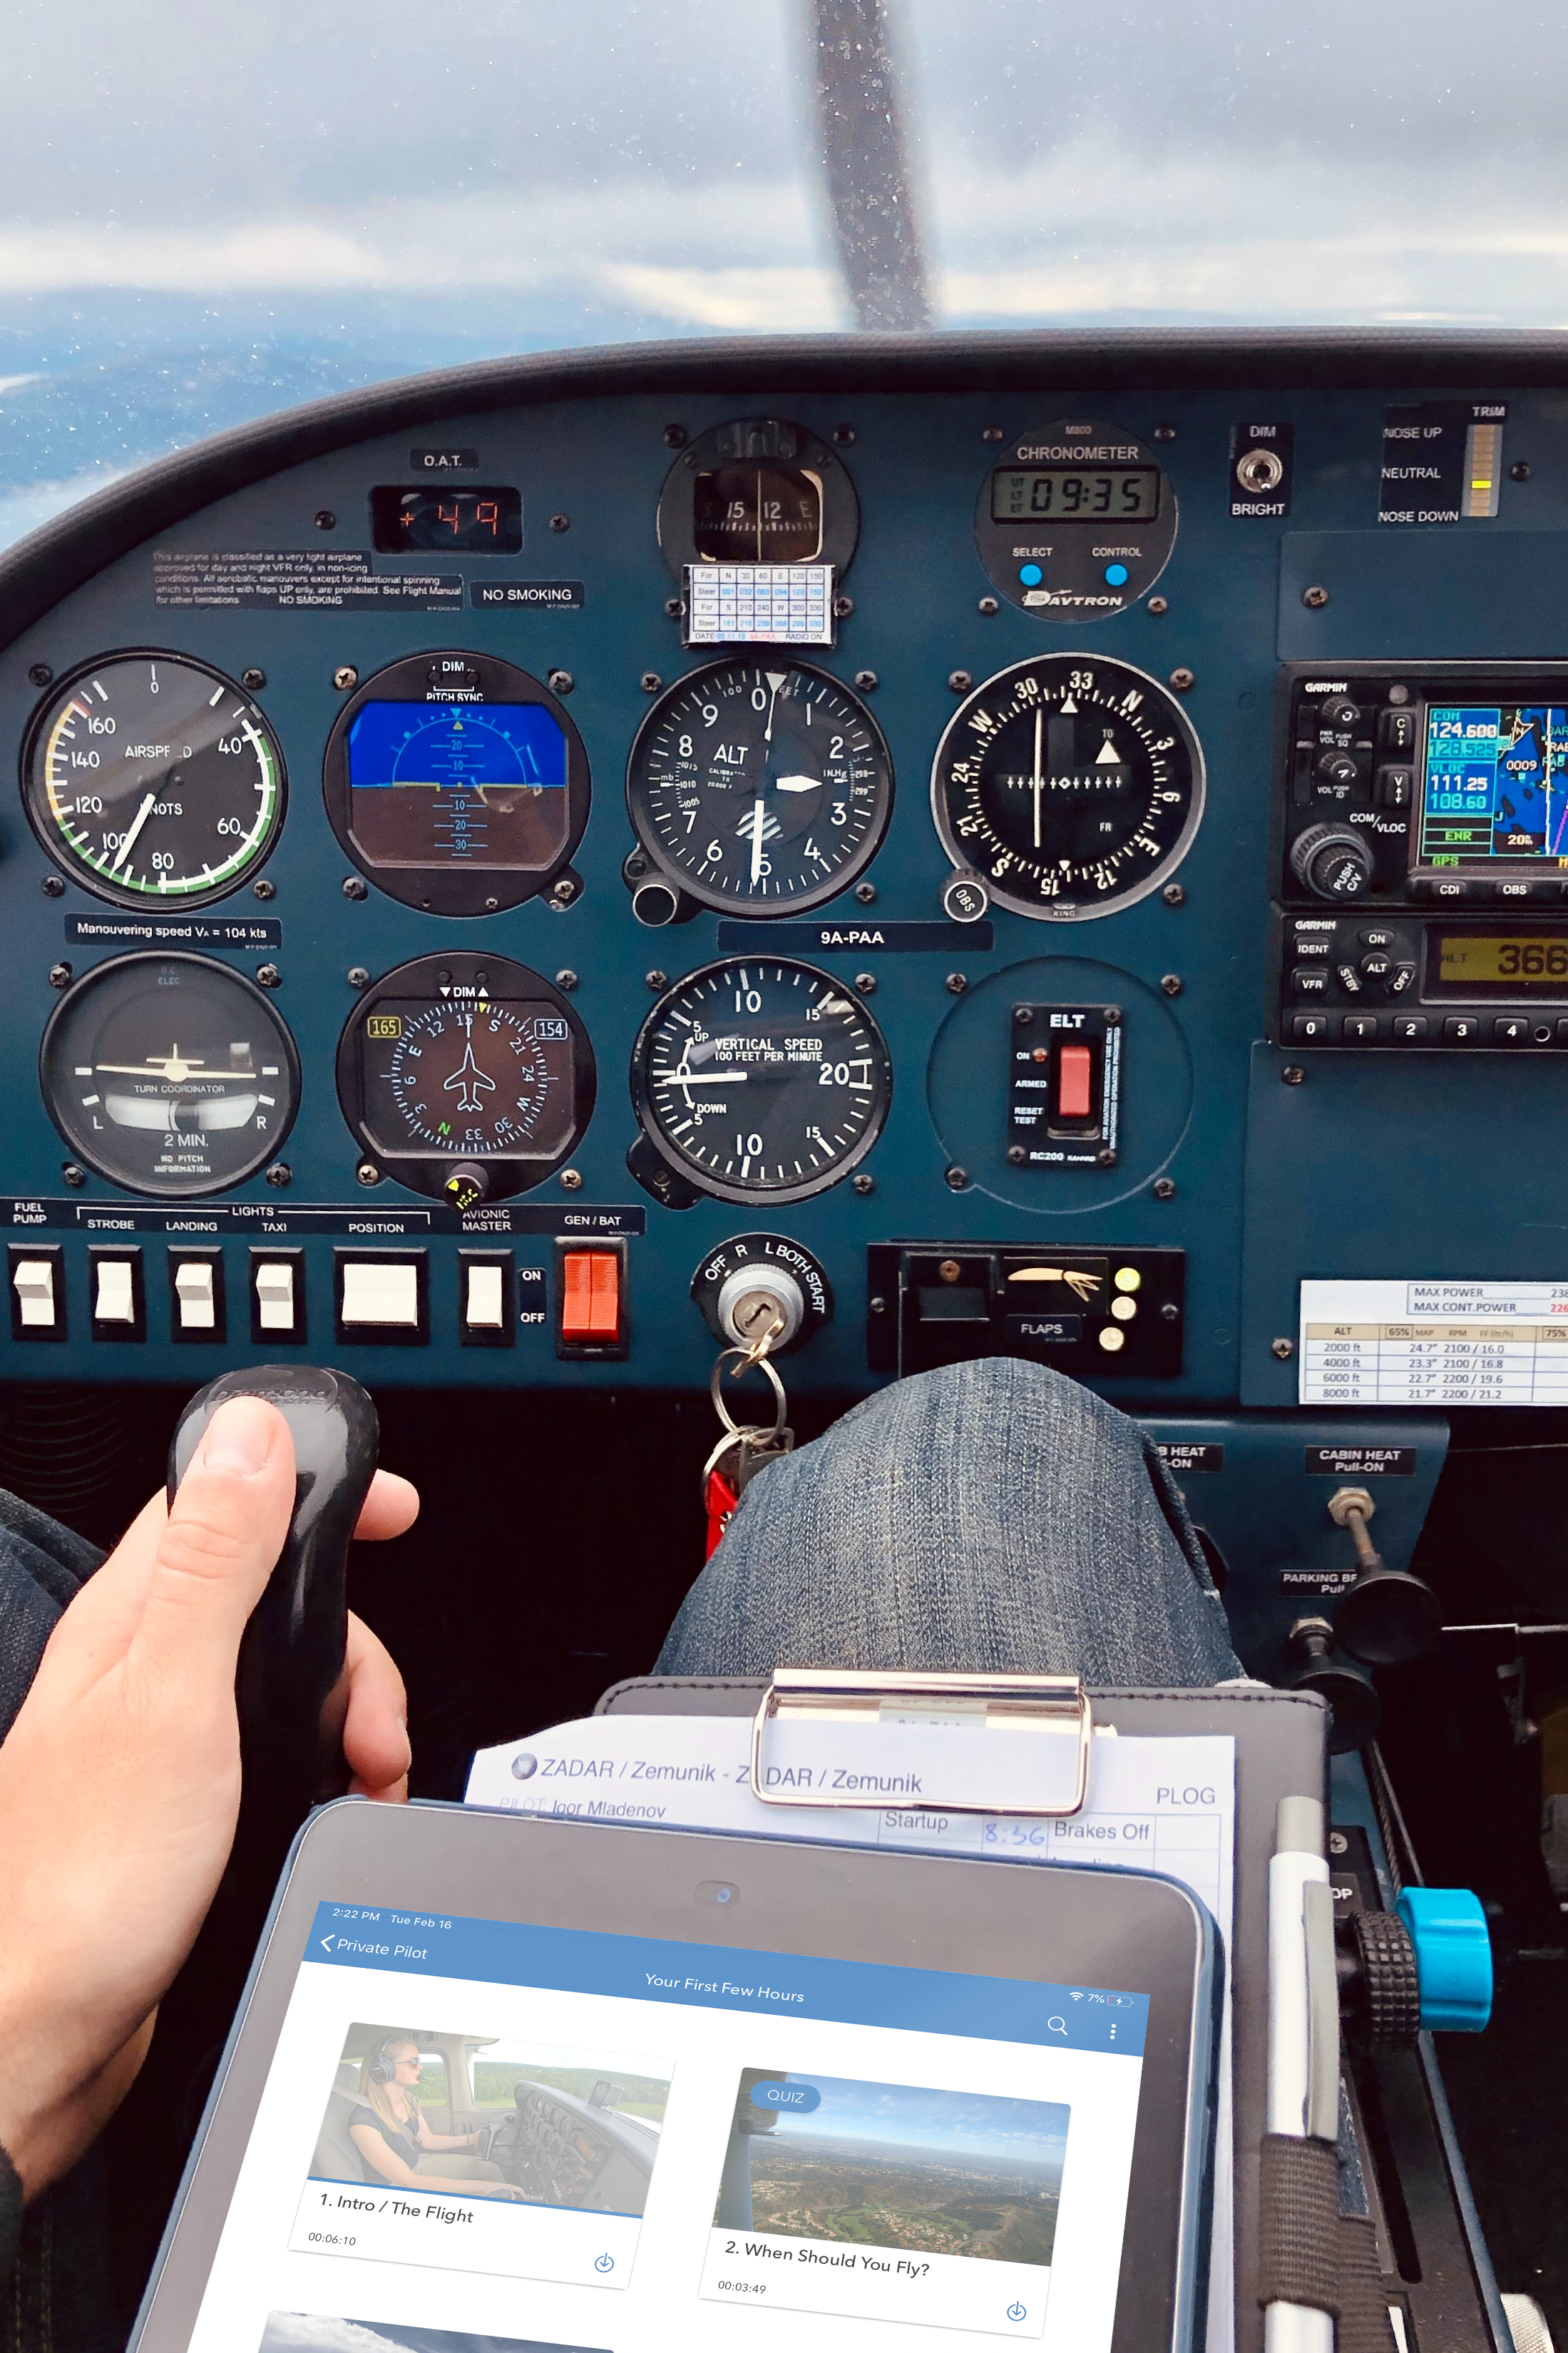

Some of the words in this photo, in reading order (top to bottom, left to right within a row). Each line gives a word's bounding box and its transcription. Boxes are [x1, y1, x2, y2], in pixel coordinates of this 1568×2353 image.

[1472, 406, 1505, 417] TRIM
[1250, 426, 1276, 437] DIM
[1383, 427, 1420, 439] NOSE
[1423, 427, 1442, 438] UP
[1017, 446, 1138, 459] CHRONOMETER
[424, 455, 461, 466] O.A.T.
[1381, 467, 1441, 479] NEUTRAL
[1031, 479, 1140, 511] 09:35
[727, 501, 744, 519] 15
[764, 501, 782, 519] 12
[1231, 503, 1285, 516] BRIGHT
[1378, 511, 1415, 522] NOSE
[1418, 511, 1458, 522] DOWN
[1013, 548, 1052, 556] SELECT
[1092, 547, 1142, 556] CONTROL
[327, 554, 362, 563] airplane
[403, 587, 427, 596] Flight
[483, 589, 504, 601] NO
[507, 589, 572, 601] SMOKING
[279, 596, 294, 604] NO
[296, 596, 343, 604] SMOKING
[442, 661, 464, 672] DIM
[1070, 670, 1095, 690] 33
[1014, 677, 1039, 700] 30
[1305, 683, 1348, 693] GARMIN
[426, 693, 455, 702] PITCH
[88, 718, 116, 735] 160
[1429, 722, 1497, 738] 124.600
[1102, 729, 1114, 738] TO
[218, 737, 242, 755] 40
[714, 744, 749, 765] ALT
[1506, 760, 1537, 771] 0009
[680, 780, 696, 789] 1010
[1430, 775, 1488, 791] 111.25
[1430, 793, 1486, 810] 108.60
[1377, 823, 1406, 833] VLOC
[1445, 831, 1472, 841] ENR
[1432, 856, 1460, 866] GPS
[1439, 884, 1460, 895] CDI
[1502, 884, 1527, 895] OBS
[955, 888, 975, 913] OBS
[1295, 919, 1336, 931] GARMIN
[77, 923, 153, 938] Manouvering
[155, 926, 192, 938] speed
[225, 927, 246, 938] 104
[250, 927, 267, 939] kts
[821, 931, 885, 944] 9A-PAA
[1368, 934, 1385, 944] ON
[1298, 944, 1328, 954] IDENT
[1367, 963, 1387, 973] ALT
[1302, 980, 1323, 989] VFR
[1339, 968, 1359, 993] STBY
[1393, 971, 1410, 991] OFF
[454, 986, 476, 997] DIM
[1050, 1014, 1085, 1028] ELT
[372, 1019, 396, 1035] 165
[539, 1021, 563, 1036] 154
[695, 1032, 709, 1042] UP
[715, 1038, 775, 1051] VERTICAL
[784, 1038, 822, 1051] SPEED
[715, 1051, 734, 1061] 100
[736, 1051, 762, 1061] FEET
[764, 1051, 784, 1061] PER
[787, 1051, 822, 1062] MINUTE
[1016, 1052, 1030, 1061] ON
[134, 1085, 158, 1093] TURN
[161, 1085, 225, 1093] COORDINATOR
[1015, 1080, 1047, 1088] ARMED
[697, 1104, 727, 1113] DOWN
[1015, 1116, 1036, 1125] TEST
[164, 1134, 174, 1147] 2
[178, 1134, 209, 1147] MIN.
[1030, 1152, 1064, 1161] RC200
[15, 1203, 45, 1213] FUEL
[232, 1207, 275, 1216] LIGHTS
[14, 1214, 47, 1224] PUMP
[463, 1210, 511, 1220] AVIONIC
[87, 1220, 135, 1230] STROBE
[165, 1221, 217, 1232] LANDING
[462, 1221, 512, 1230] MASTER
[564, 1215, 590, 1225] GEN
[599, 1216, 622, 1227] BAT
[262, 1223, 287, 1232] TAXI
[349, 1223, 404, 1233] POSITION
[776, 1245, 812, 1273] BOTH
[704, 1255, 727, 1281] OFF
[522, 1270, 541, 1281] ON
[806, 1272, 826, 1314] START
[1414, 1287, 1442, 1297] MAX
[1443, 1288, 1484, 1298] POWER
[1414, 1302, 1440, 1312] MAX
[1442, 1303, 1517, 1313] CONT.POWER
[521, 1312, 545, 1323] OFF
[1021, 1323, 1063, 1334] FLAPS
[1334, 1327, 1352, 1335] ALT
[1323, 1343, 1351, 1352] 2000
[1353, 1343, 1361, 1352] ft
[1444, 1344, 1471, 1354] 2100
[1482, 1344, 1505, 1354] 16.0
[1319, 1449, 1363, 1461] CABIN
[1365, 1450, 1401, 1461] HEAT
[1335, 1461, 1384, 1472] Pull-ON
[540, 1758, 614, 1778] ZADAR
[619, 1760, 628, 1779] /
[632, 1761, 716, 1782] Zemunik
[832, 1768, 923, 1794] Zemunik
[1157, 1786, 1216, 1806] PLOG
[588, 1800, 667, 1819] Mladenov
[885, 1811, 948, 1832] Startup
[1054, 1822, 1118, 1841] Brakes
[1122, 1822, 1150, 1842] Off
[332, 1908, 359, 1921] 2:22
[361, 1911, 381, 1921] PM
[391, 1914, 411, 1926] Tue
[414, 1917, 436, 1929] Feb
[439, 1919, 452, 1930] 16
[336, 1938, 390, 1956] Private
[394, 1944, 429, 1960] Pilot
[645, 1972, 682, 1991] Your
[683, 1976, 719, 1994] First
[721, 1981, 755, 1998] Few
[757, 1985, 804, 2003] Hours
[1087, 1993, 1106, 2004] 7%
[767, 2088, 805, 2104] QUIZ
[320, 2193, 332, 2207] 1.
[337, 2195, 376, 2213] Intro
[378, 2200, 389, 2213] /
[391, 2202, 421, 2218] The
[426, 2206, 474, 2225] Flight
[307, 2232, 357, 2247] 00:06:10
[724, 2241, 740, 2255] 2.
[744, 2242, 794, 2262] When
[797, 2249, 856, 2268] Should
[861, 2256, 892, 2272] You
[896, 2260, 931, 2278] Fly?
[717, 2280, 767, 2295] 00:03:49
